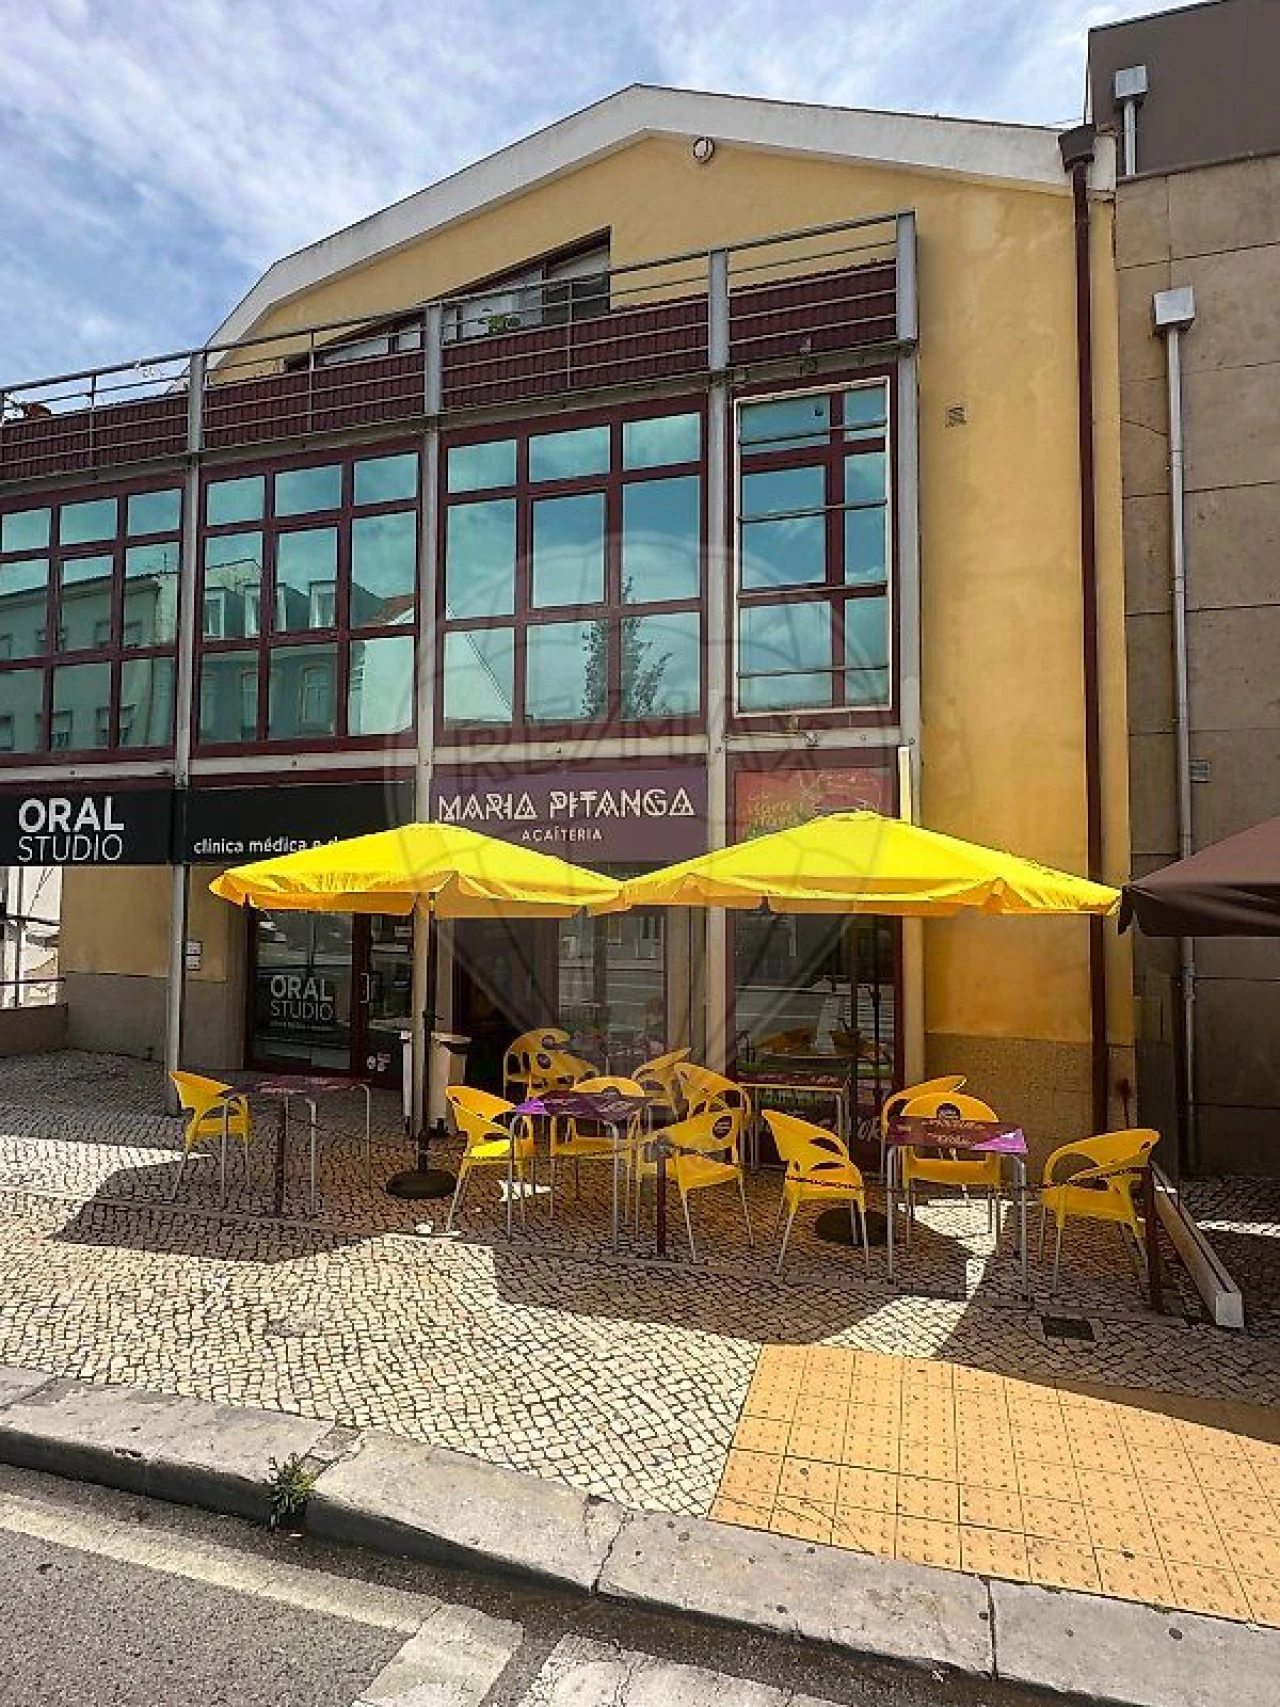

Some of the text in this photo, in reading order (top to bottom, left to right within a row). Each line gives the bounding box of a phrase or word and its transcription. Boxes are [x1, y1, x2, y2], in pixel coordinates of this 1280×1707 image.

[18, 796, 125, 833] ORAL
[438, 787, 695, 821] MARIA PITANGA
[17, 833, 124, 862] STUDIO
[249, 835, 307, 853] médica
[270, 974, 334, 1002] ORAL
[270, 1000, 334, 1022] STUDIO
